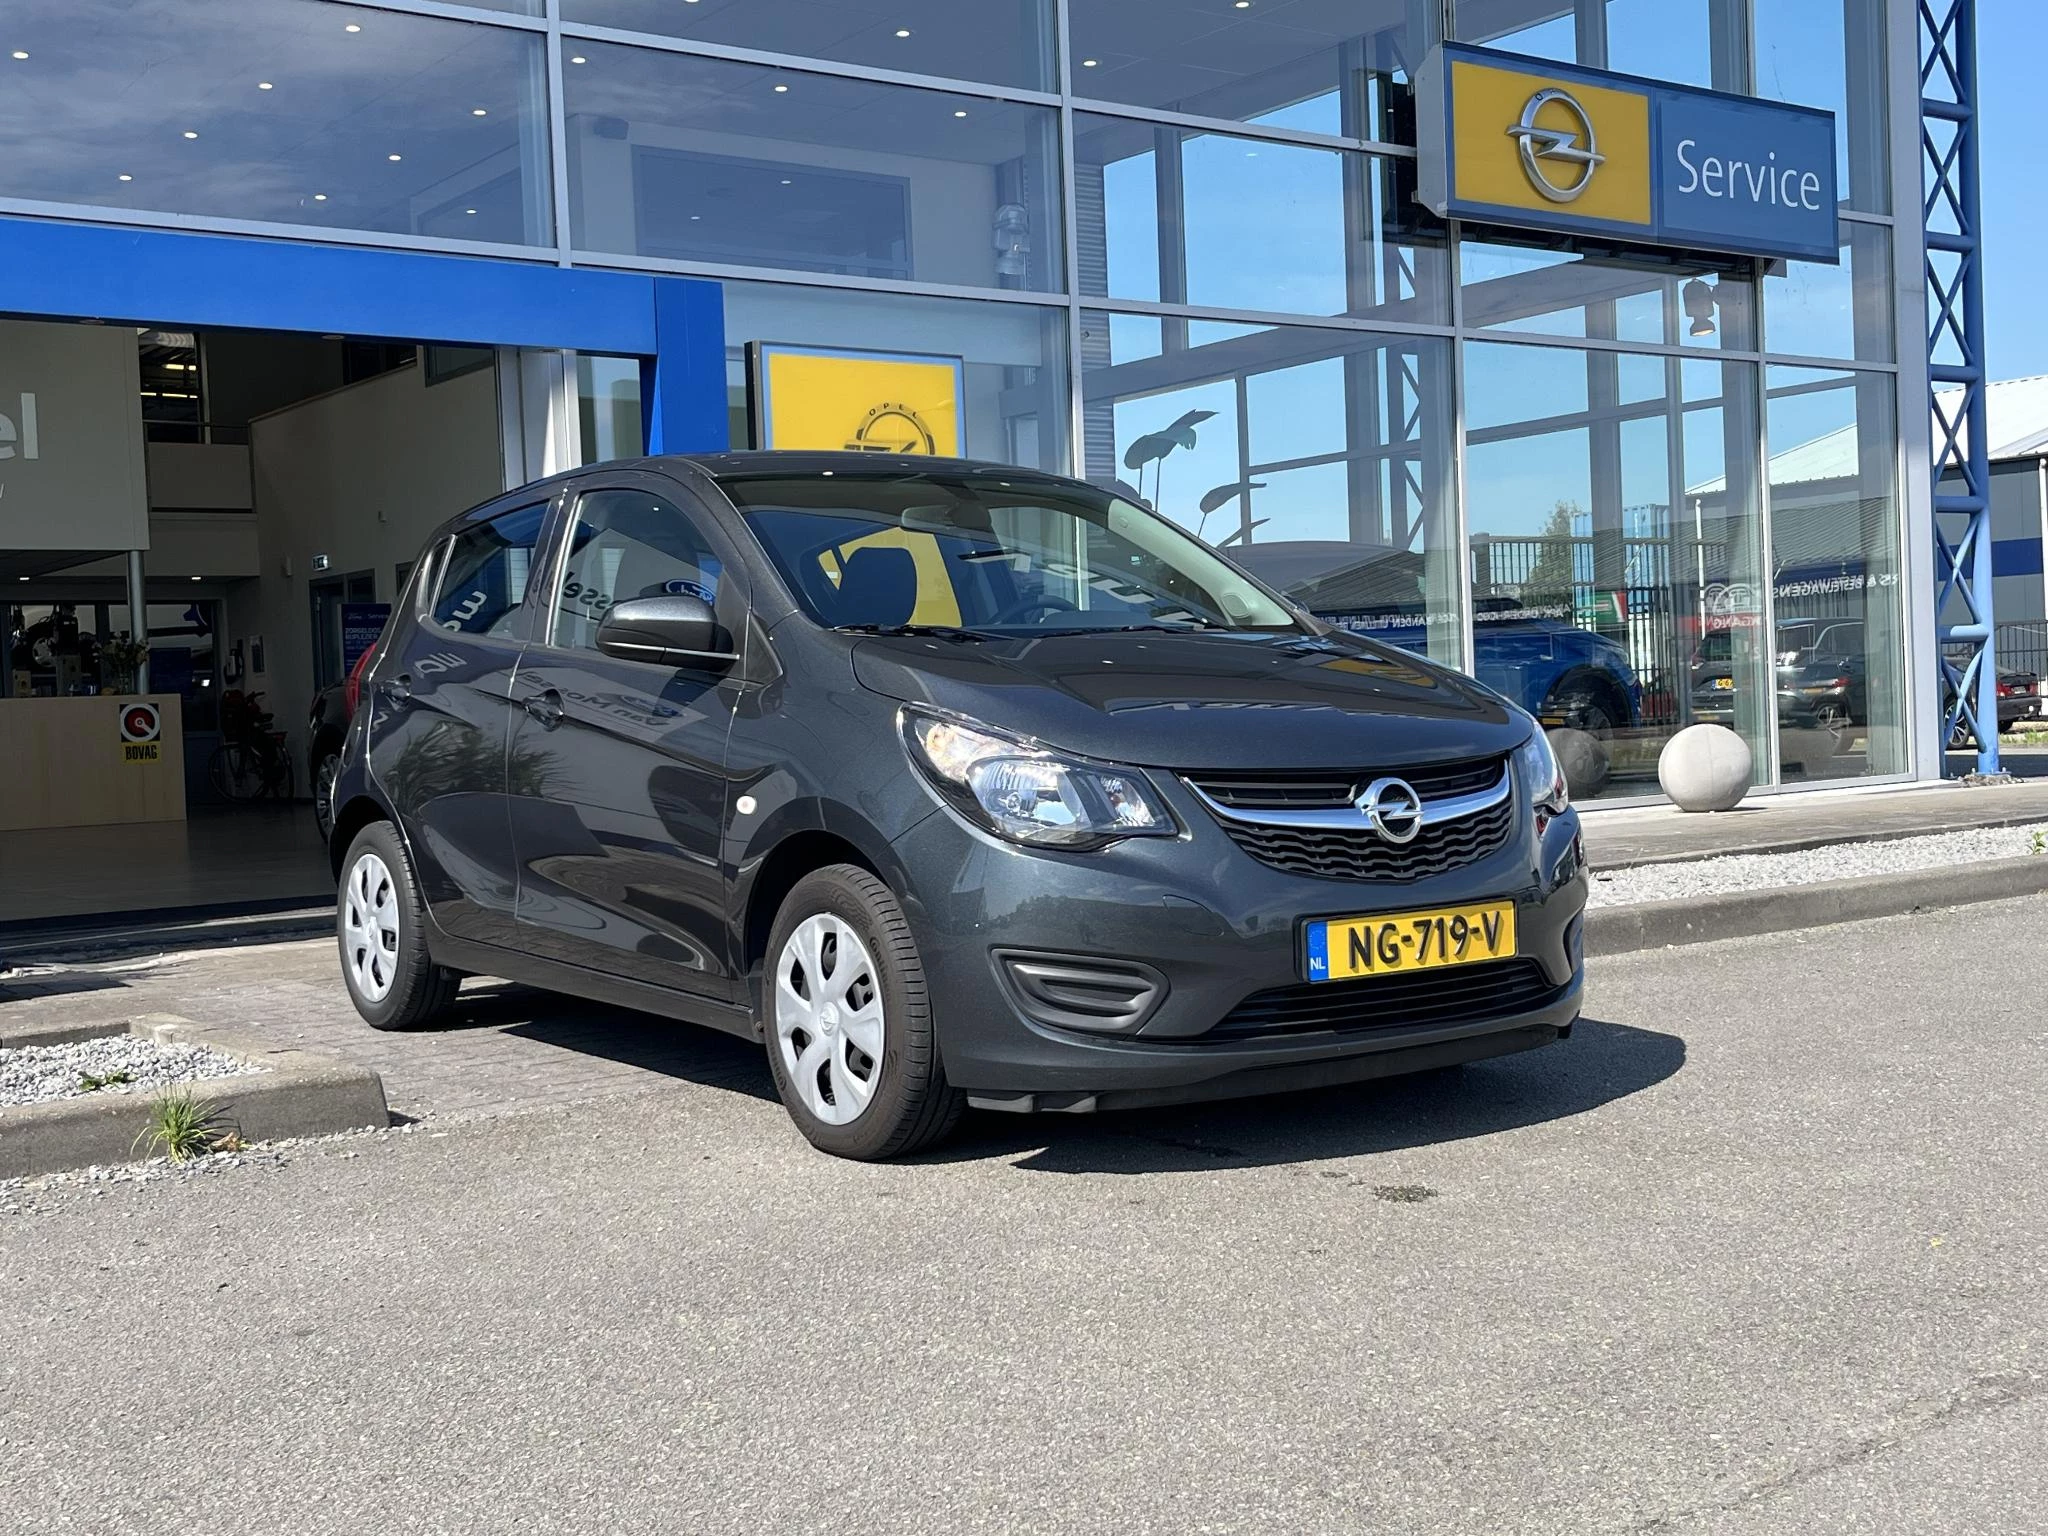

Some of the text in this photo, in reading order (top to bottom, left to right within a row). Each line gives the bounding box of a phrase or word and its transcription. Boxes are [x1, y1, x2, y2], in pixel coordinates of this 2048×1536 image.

[1676, 139, 1820, 211] Service
[869, 402, 917, 419] OPEL
[125, 745, 157, 760] BOVAG
[1310, 910, 1502, 970] NL NG-719-V
